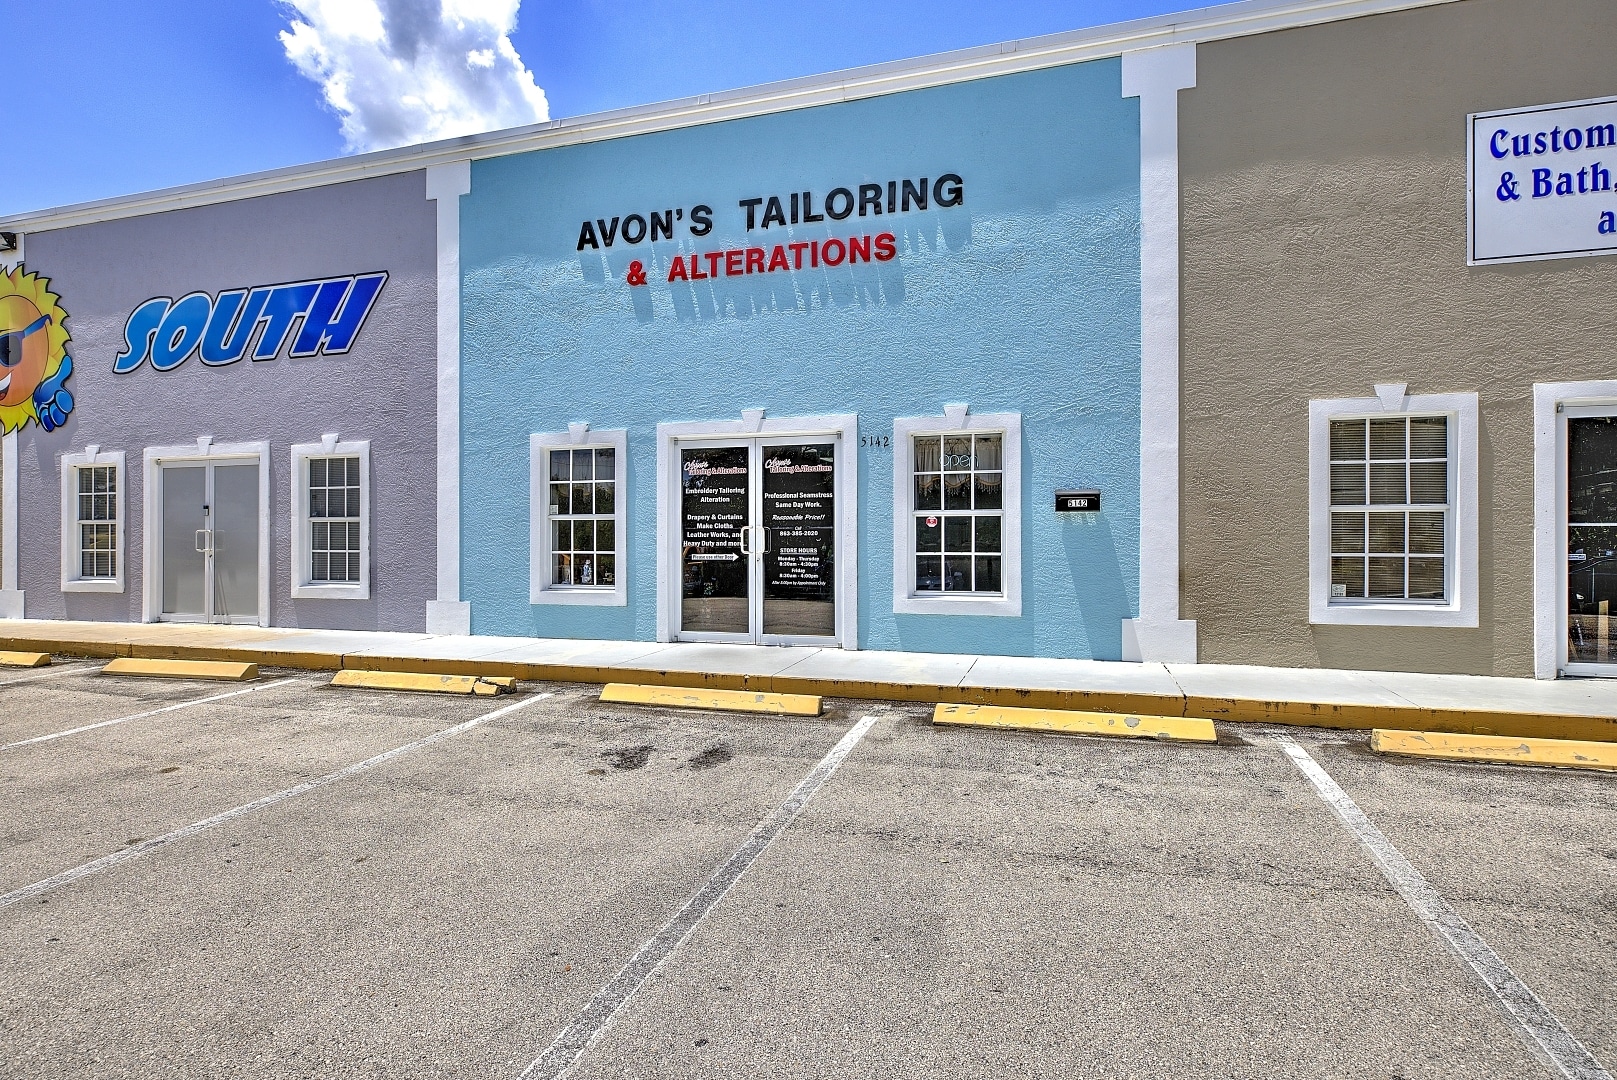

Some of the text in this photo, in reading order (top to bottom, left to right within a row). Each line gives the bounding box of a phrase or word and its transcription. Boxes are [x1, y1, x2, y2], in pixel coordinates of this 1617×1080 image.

[1490, 123, 1617, 159] Custom
[1496, 171, 1520, 201] &
[576, 173, 963, 250] AVON'S TAILORING
[627, 233, 896, 286] & ALTERATIONS
[113, 271, 389, 374] SOUTH
[861, 436, 889, 448] 5142
[685, 487, 745, 495] Embroidery Tailoring
[1068, 499, 1087, 507] 5142
[710, 531, 731, 539] Works,
